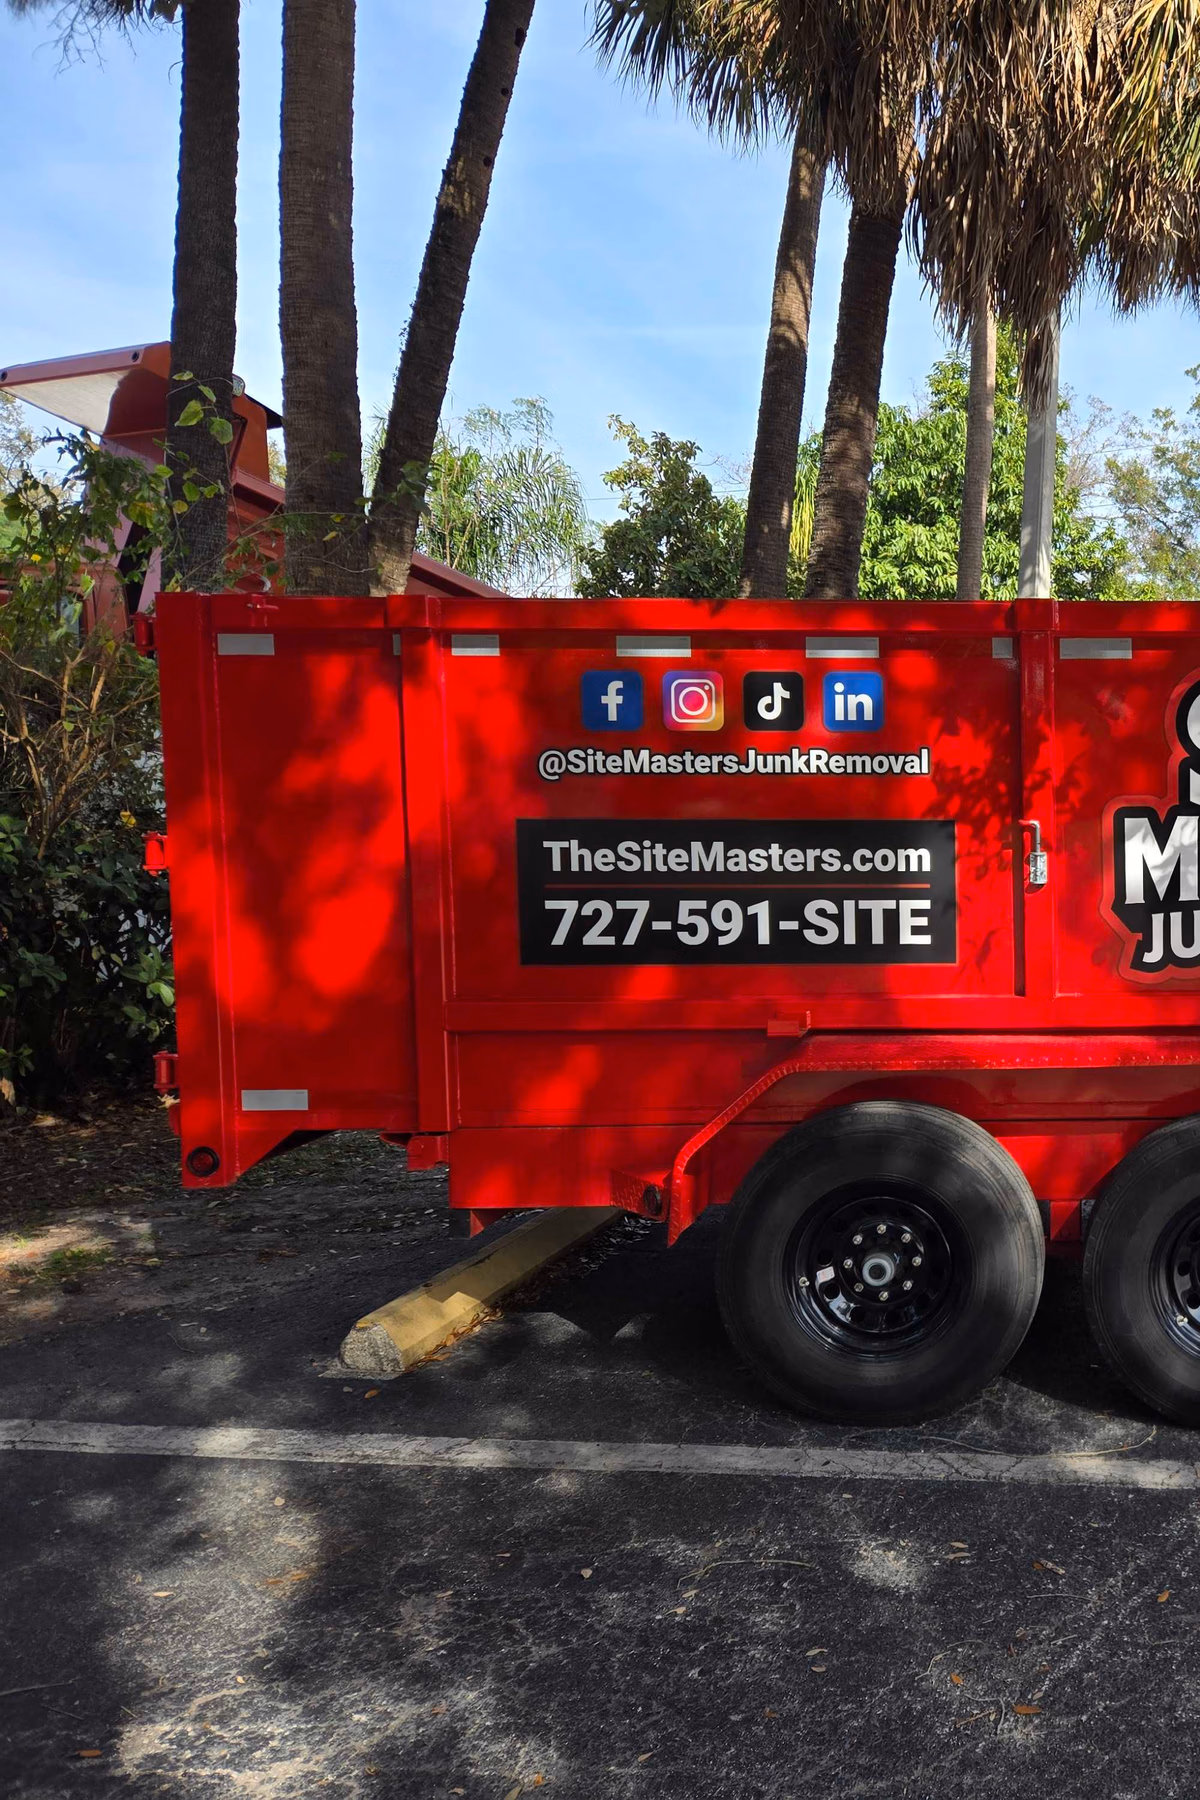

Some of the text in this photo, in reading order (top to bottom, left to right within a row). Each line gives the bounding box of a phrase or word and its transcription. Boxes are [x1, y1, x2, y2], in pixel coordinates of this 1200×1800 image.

[834, 682, 874, 722] in
[538, 748, 930, 780] @SiteMastersJunkRemoval
[543, 840, 931, 872] TheSiteMasters.com
[544, 899, 932, 946] 727-591-SITE
